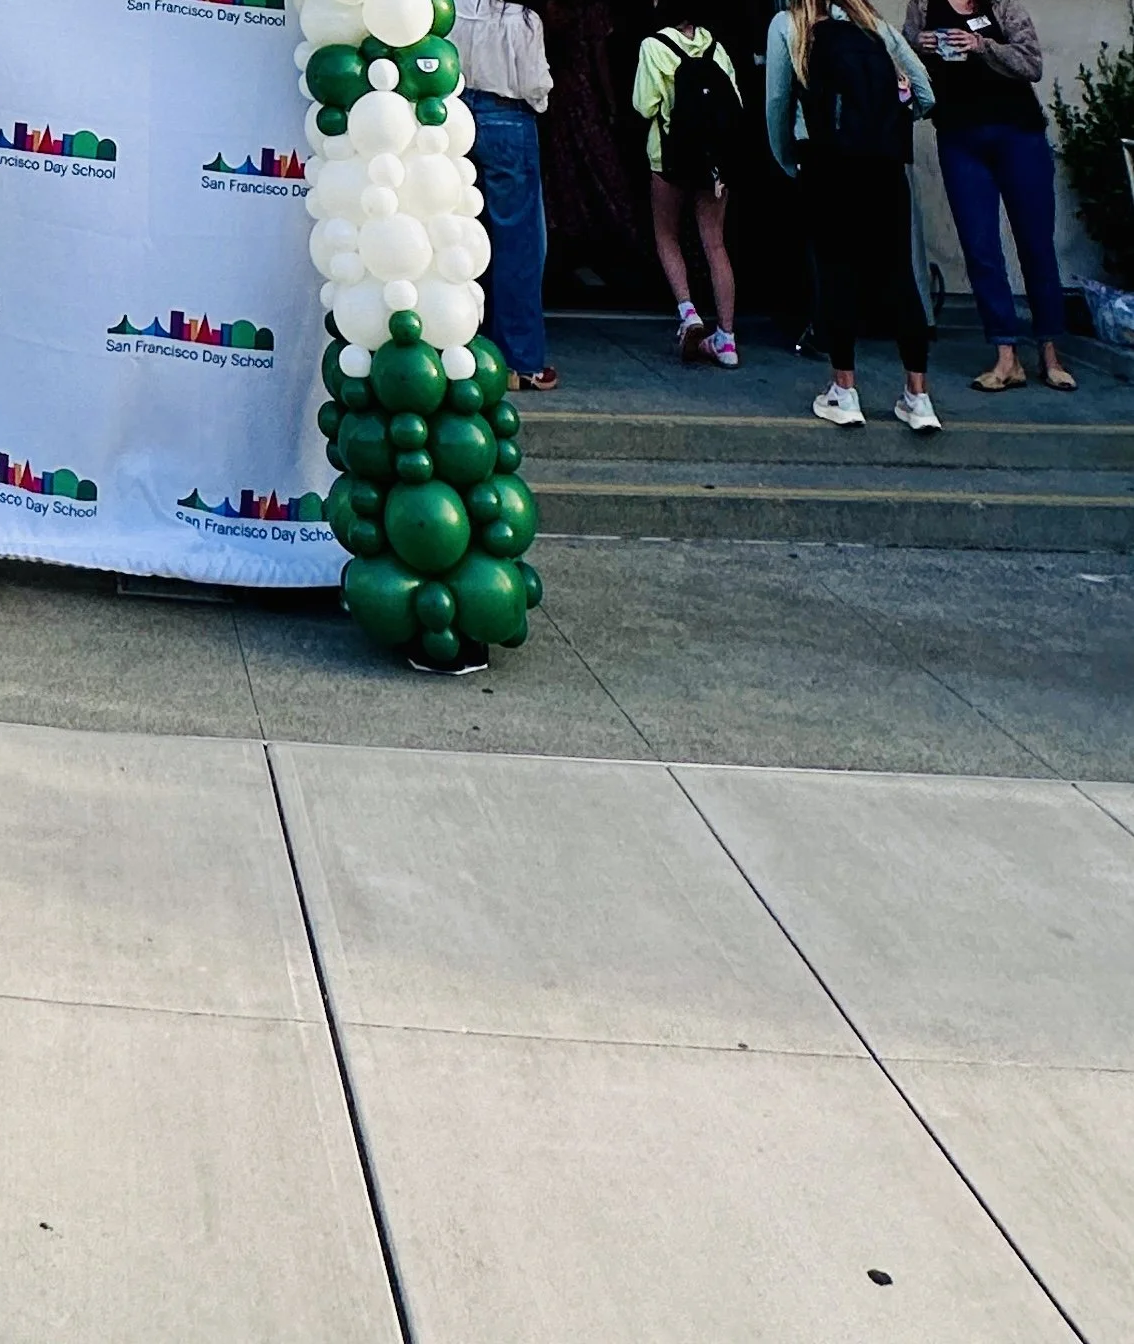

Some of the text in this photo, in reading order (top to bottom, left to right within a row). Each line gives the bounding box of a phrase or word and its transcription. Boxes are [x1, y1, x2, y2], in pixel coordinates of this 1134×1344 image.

[154, 0, 213, 19] Francisco
[217, 8, 241, 25] Day
[243, 11, 286, 27] School
[43, 160, 68, 177] Day
[71, 163, 116, 180] School
[201, 176, 225, 190] San
[229, 179, 288, 196] Francisco
[105, 339, 274, 369] San Francisco Day School
[25, 496, 49, 517] Day
[52, 501, 97, 518] School
[204, 518, 267, 540] Francisco
[271, 526, 296, 545] Day
[299, 527, 335, 542] Scho
